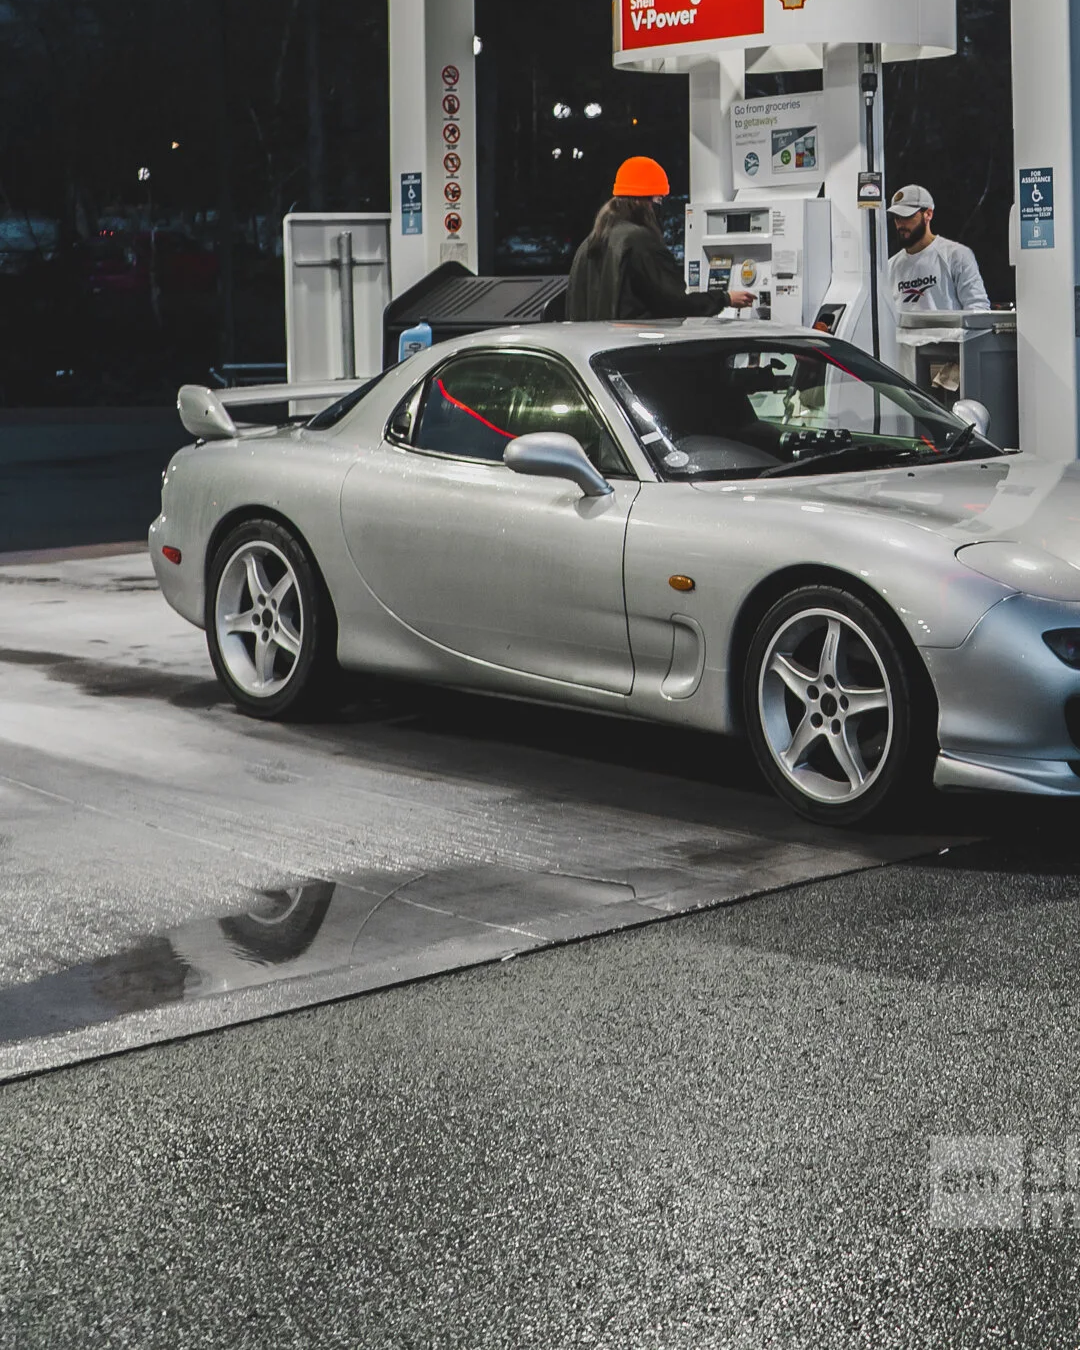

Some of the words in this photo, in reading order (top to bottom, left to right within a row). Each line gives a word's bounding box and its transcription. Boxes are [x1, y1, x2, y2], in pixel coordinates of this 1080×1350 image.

[630, 8, 698, 31] V-Power
[734, 105, 745, 115] Go
[746, 103, 764, 114] from
[765, 99, 801, 114] groceries
[735, 120, 742, 128] to
[743, 116, 778, 130] getaways
[1021, 175, 1051, 184] ASSISTANCE
[897, 274, 937, 292] Reebok
